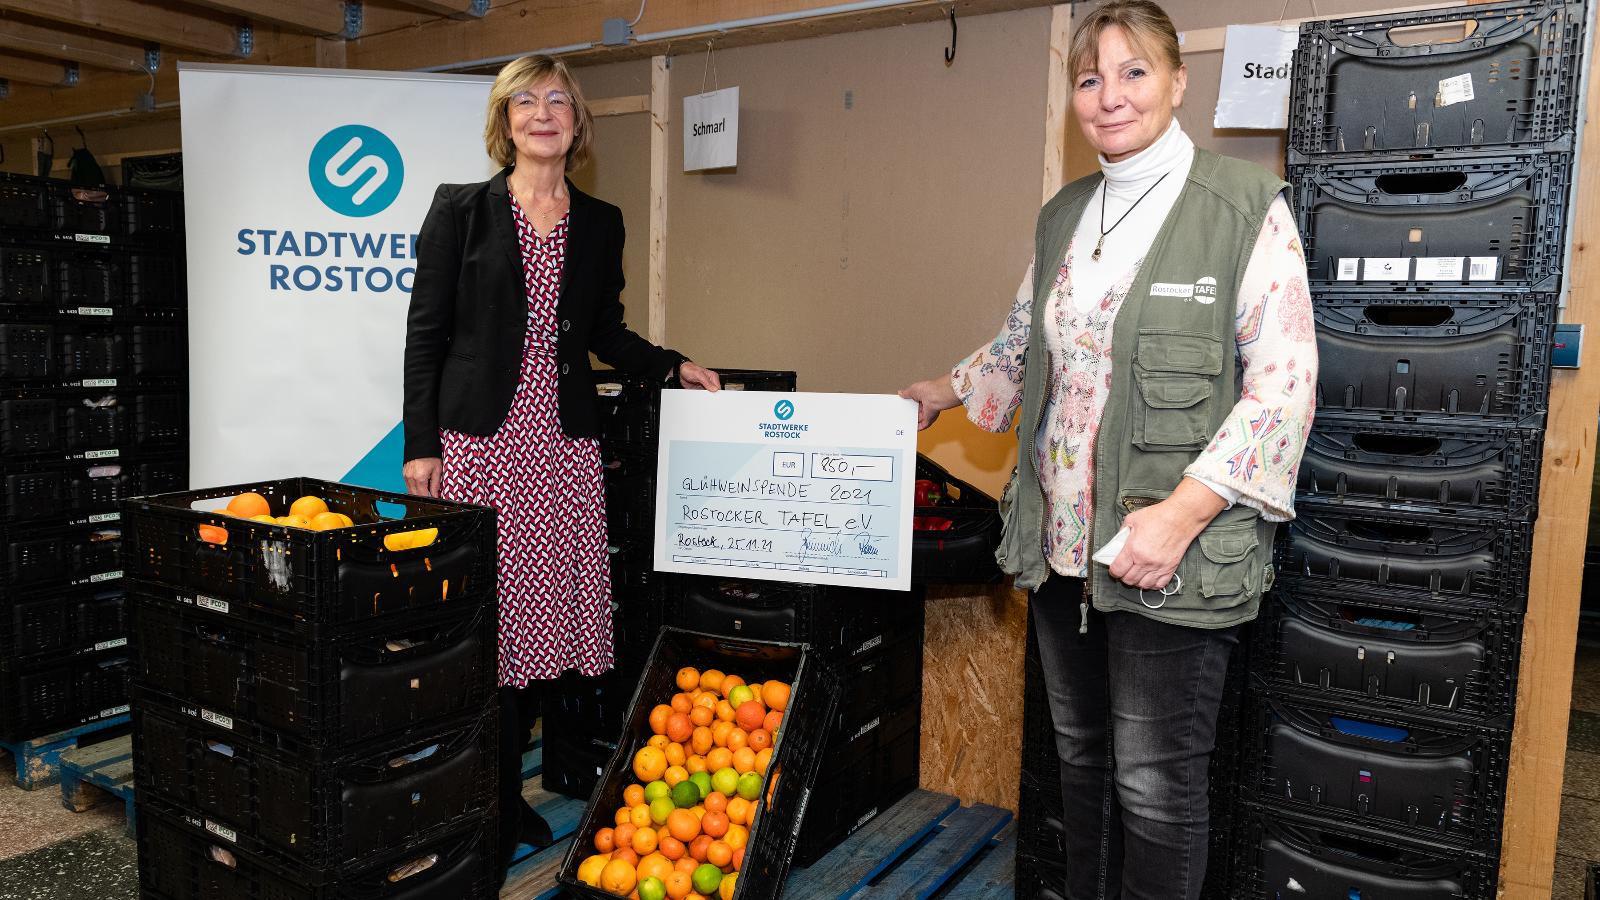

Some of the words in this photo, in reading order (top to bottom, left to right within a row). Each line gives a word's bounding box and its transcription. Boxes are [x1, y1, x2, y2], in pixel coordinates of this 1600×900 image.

[1243, 62, 1291, 79] Stad
[693, 118, 725, 137] Schmarl
[758, 422, 808, 431] STADTWERKE
[764, 431, 800, 439] ROSTOCK
[682, 475, 811, 498] GLÜHWEINSPENDE
[831, 484, 871, 504] 2021
[682, 504, 768, 525] ROSTOCKER
[778, 511, 840, 528] TAFEL
